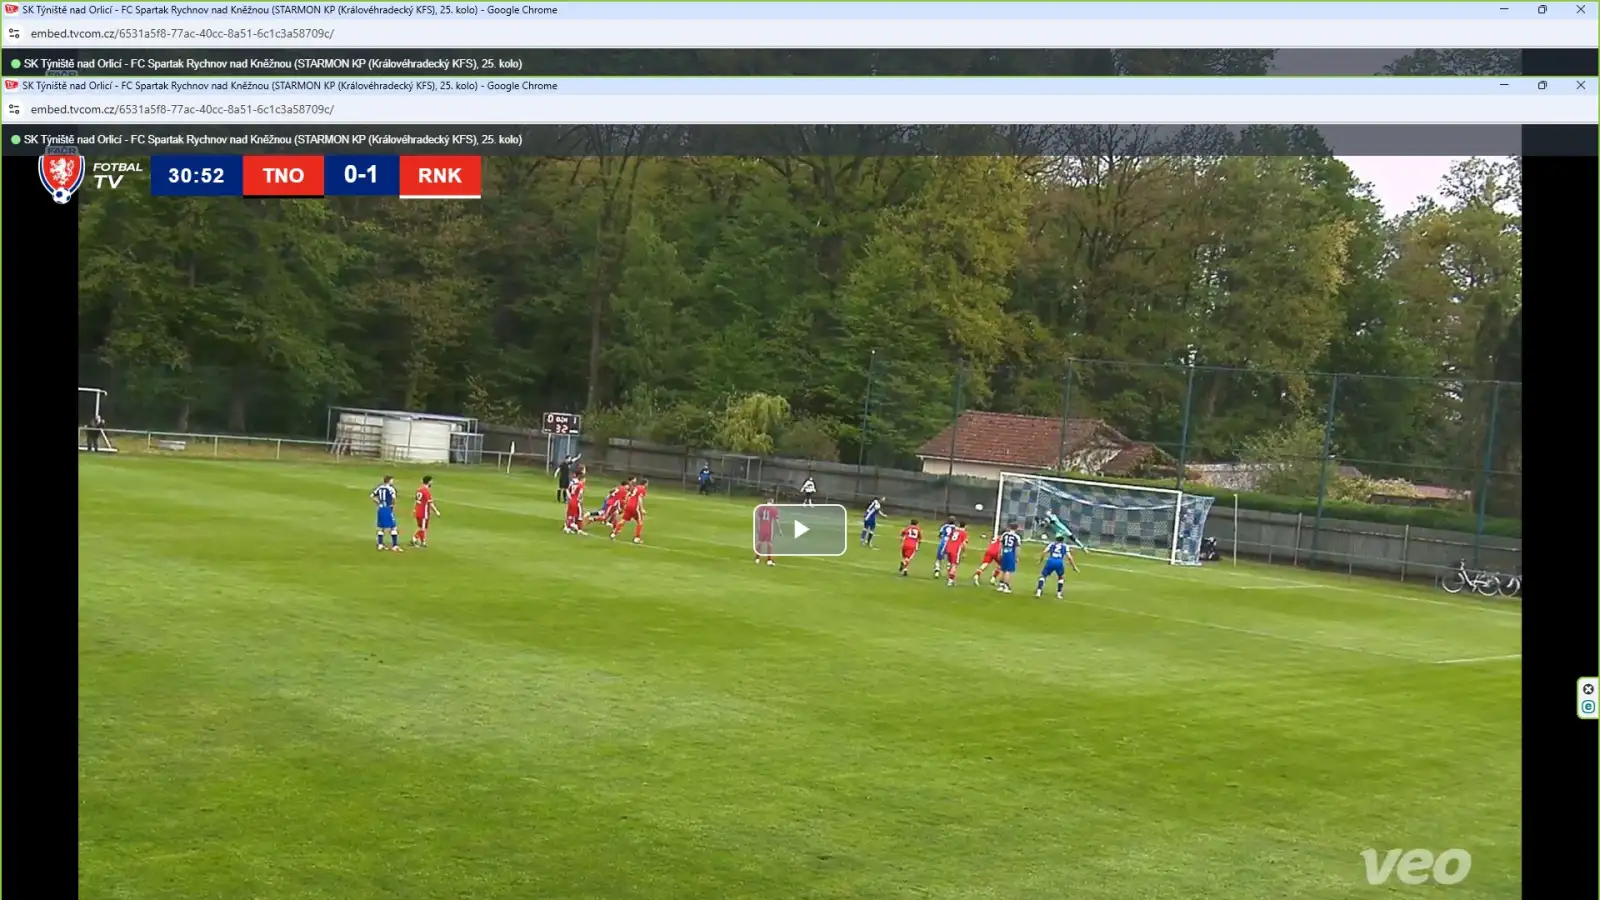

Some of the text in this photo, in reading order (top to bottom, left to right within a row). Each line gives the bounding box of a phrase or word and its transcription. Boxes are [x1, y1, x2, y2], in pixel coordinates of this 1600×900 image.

[22, 6, 34, 14] SK
[35, 6, 67, 16] Týniště
[69, 6, 86, 14] nad
[88, 6, 113, 14] Orlicí
[121, 6, 132, 14] FC
[135, 6, 168, 16] Spartak
[171, 6, 208, 16] Rychnov
[211, 6, 227, 14] nad
[230, 6, 269, 14] Kněžnou
[271, 6, 320, 15] (STARMON
[337, 6, 413, 16] (Královéhradecký
[416, 6, 437, 15] KFS),
[439, 6, 453, 14] 25.
[455, 6, 477, 15] kolo)
[486, 6, 519, 16] Google
[521, 6, 557, 14] Chrome
[31, 28, 335, 40] embed.tvcom.cz/6531a5f8-77ac-40cc-8a51-6c1c3a58709c/
[23, 59, 38, 68] SK
[40, 59, 74, 70] Týniště
[76, 59, 95, 68] nad
[97, 59, 122, 68] Orlicí
[130, 59, 145, 68] FC
[147, 59, 184, 70] Spartak
[186, 59, 227, 70] Rychnov
[229, 59, 247, 68] nad
[250, 59, 291, 68] Kněžnou
[293, 59, 349, 70] (STARMON
[351, 59, 366, 68] KP
[367, 59, 449, 70] (Královéhradecký
[452, 59, 478, 70] KFS),
[481, 59, 496, 68] 25.
[498, 59, 522, 70] kolo)
[22, 81, 34, 89] SK
[35, 81, 67, 92] Týniště
[69, 81, 85, 89] nad
[88, 81, 112, 89] Orlicí
[121, 81, 132, 89] FC
[135, 81, 168, 92] Spartak
[171, 81, 209, 92] Rychnov
[211, 81, 227, 89] nad
[230, 81, 268, 89] Kněžnou
[271, 81, 320, 91] (STARMON
[323, 81, 335, 89] KP
[337, 81, 413, 92] (Královéhradecký
[416, 81, 437, 91] KFS),
[439, 81, 453, 89] 25.
[455, 81, 477, 91] kolo)
[486, 81, 519, 92] Google
[521, 81, 557, 89] Chrome
[31, 104, 335, 116] embed.tvcom.cz/6531a5f8-77ac-40cc-8a51-6c1c3a58709c/
[23, 135, 38, 143] SK
[40, 135, 74, 146] Týniště
[76, 135, 95, 143] nad
[97, 135, 122, 143] Orlicí
[130, 135, 145, 144] FC
[147, 135, 184, 146] Spartak
[186, 135, 227, 146] Rychnov
[229, 135, 247, 144] nad
[250, 135, 291, 143] Kněžnou
[293, 135, 349, 146] (STARMON
[351, 135, 366, 143] KP
[368, 135, 449, 146] (Královéhradecký
[452, 135, 478, 146] KFS),
[481, 135, 496, 144] 25.
[498, 135, 522, 146] kolo)
[379, 489, 387, 501] 11
[951, 531, 960, 541] 8
[1004, 535, 1015, 547] 15
